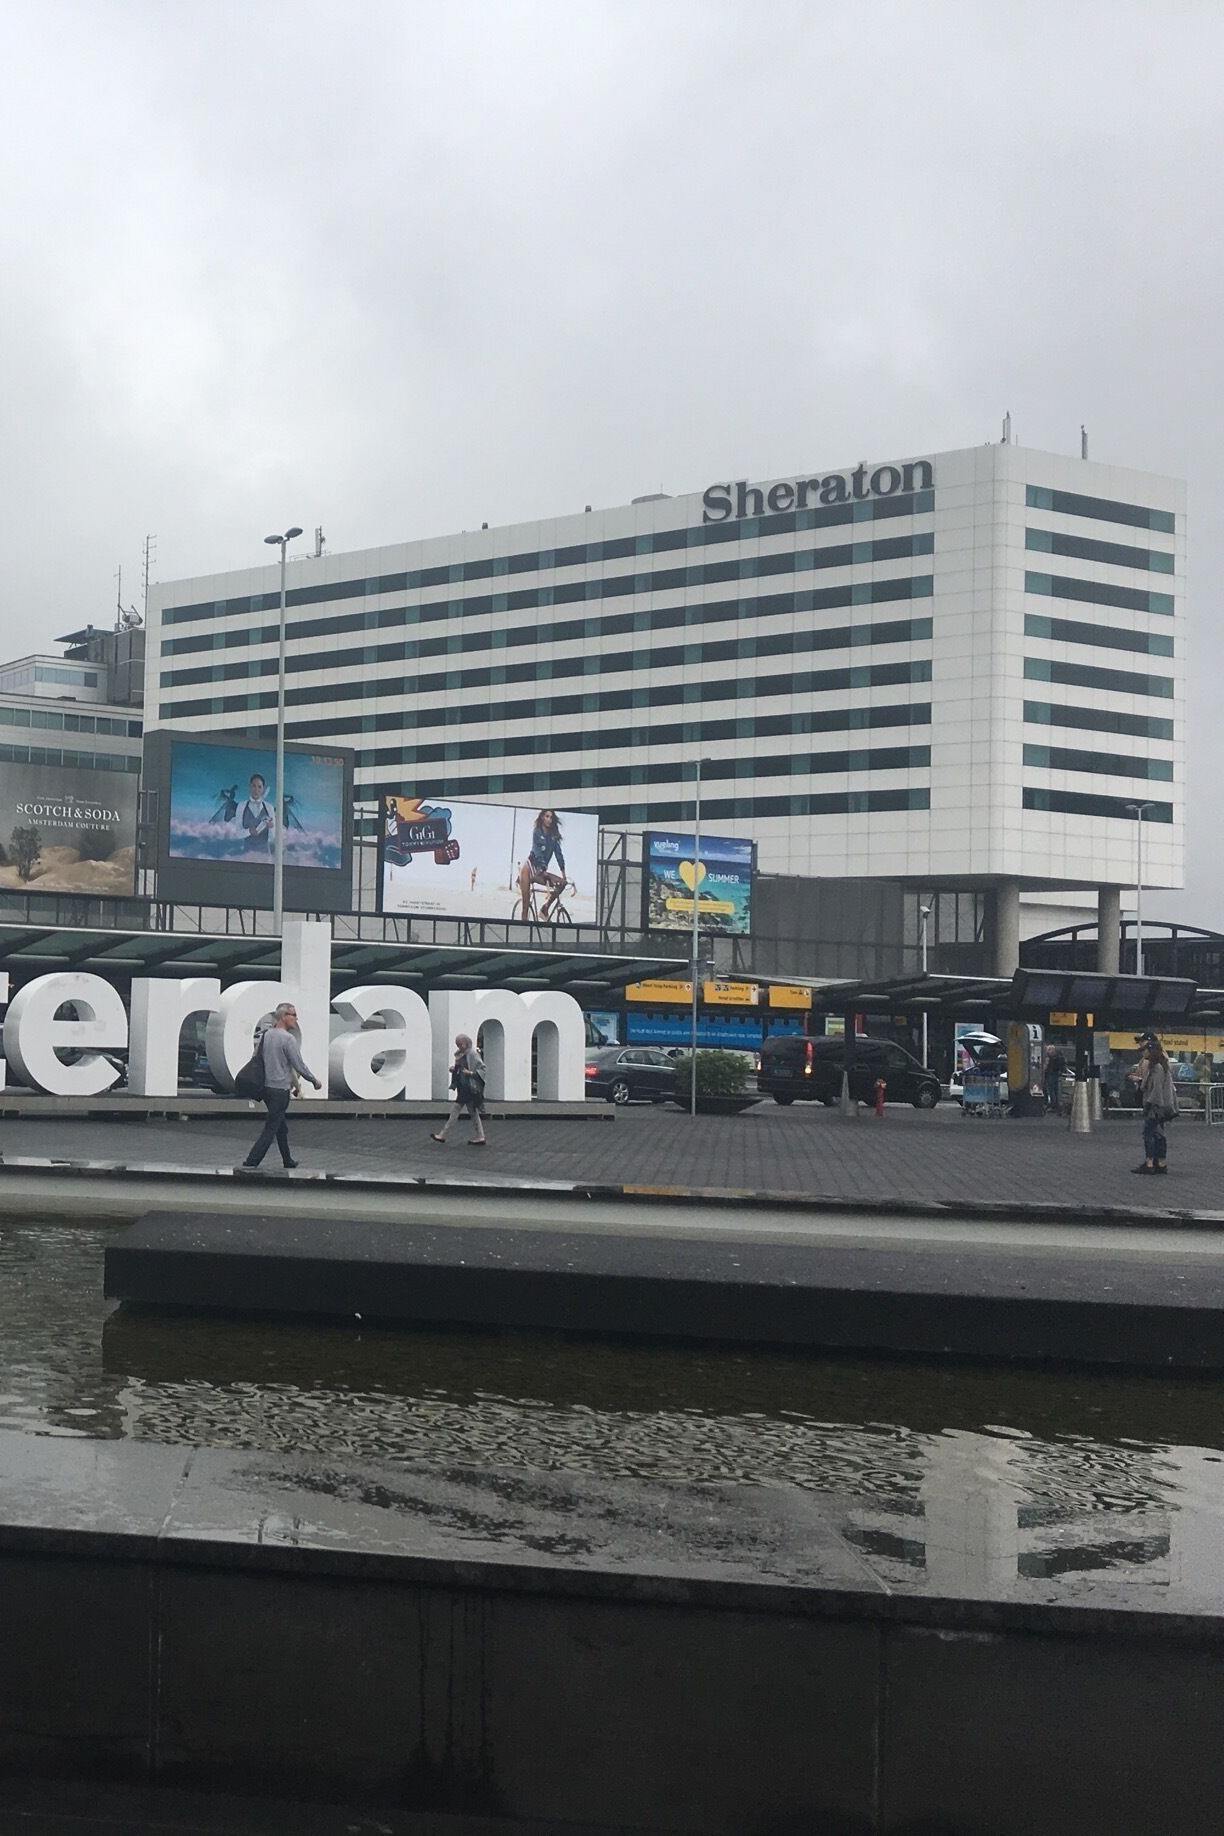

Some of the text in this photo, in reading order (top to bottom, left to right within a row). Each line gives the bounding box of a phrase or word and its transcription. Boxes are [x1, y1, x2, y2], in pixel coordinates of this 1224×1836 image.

[702, 459, 935, 524] Sheraton
[28, 819, 110, 830] AMSTERDAM COUTURE
[664, 870, 740, 884] WE SUMMER
